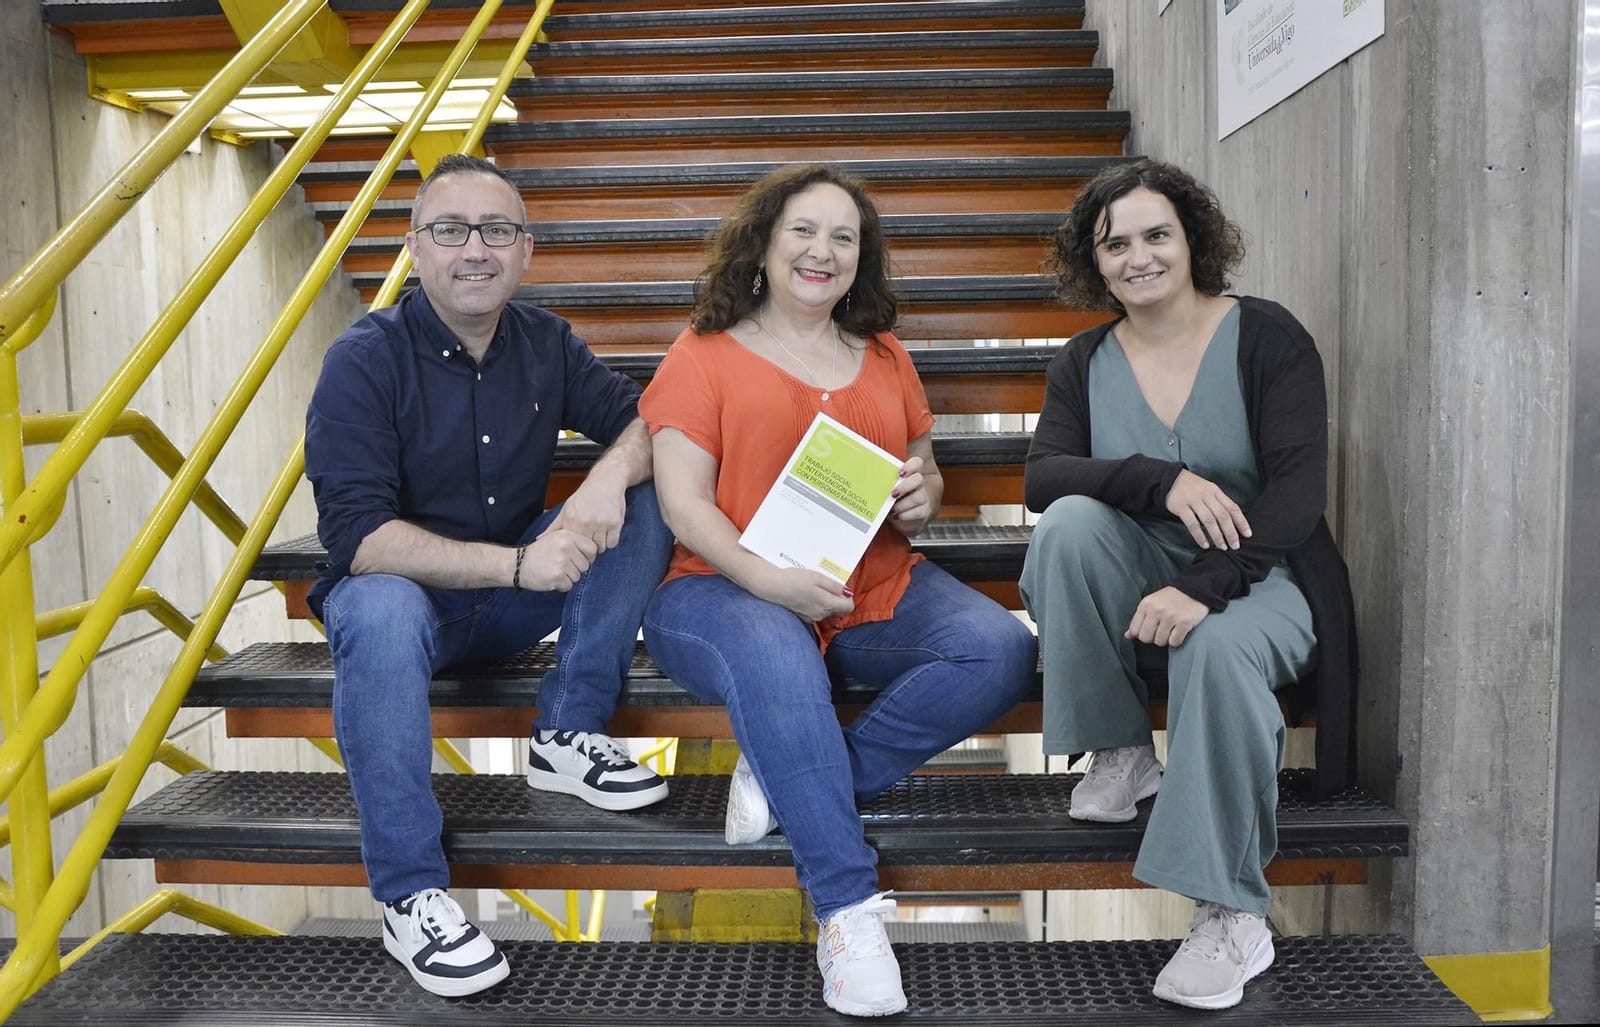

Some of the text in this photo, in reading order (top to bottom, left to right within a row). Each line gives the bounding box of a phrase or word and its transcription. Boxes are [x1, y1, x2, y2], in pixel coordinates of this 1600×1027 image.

[804, 455, 853, 488] TRABAJO SOCIAL
[796, 468, 810, 480] CON
[809, 476, 841, 498] PERSONAS
[840, 495, 875, 519] MIGRANTES
[846, 490, 869, 506] SOCIAL
